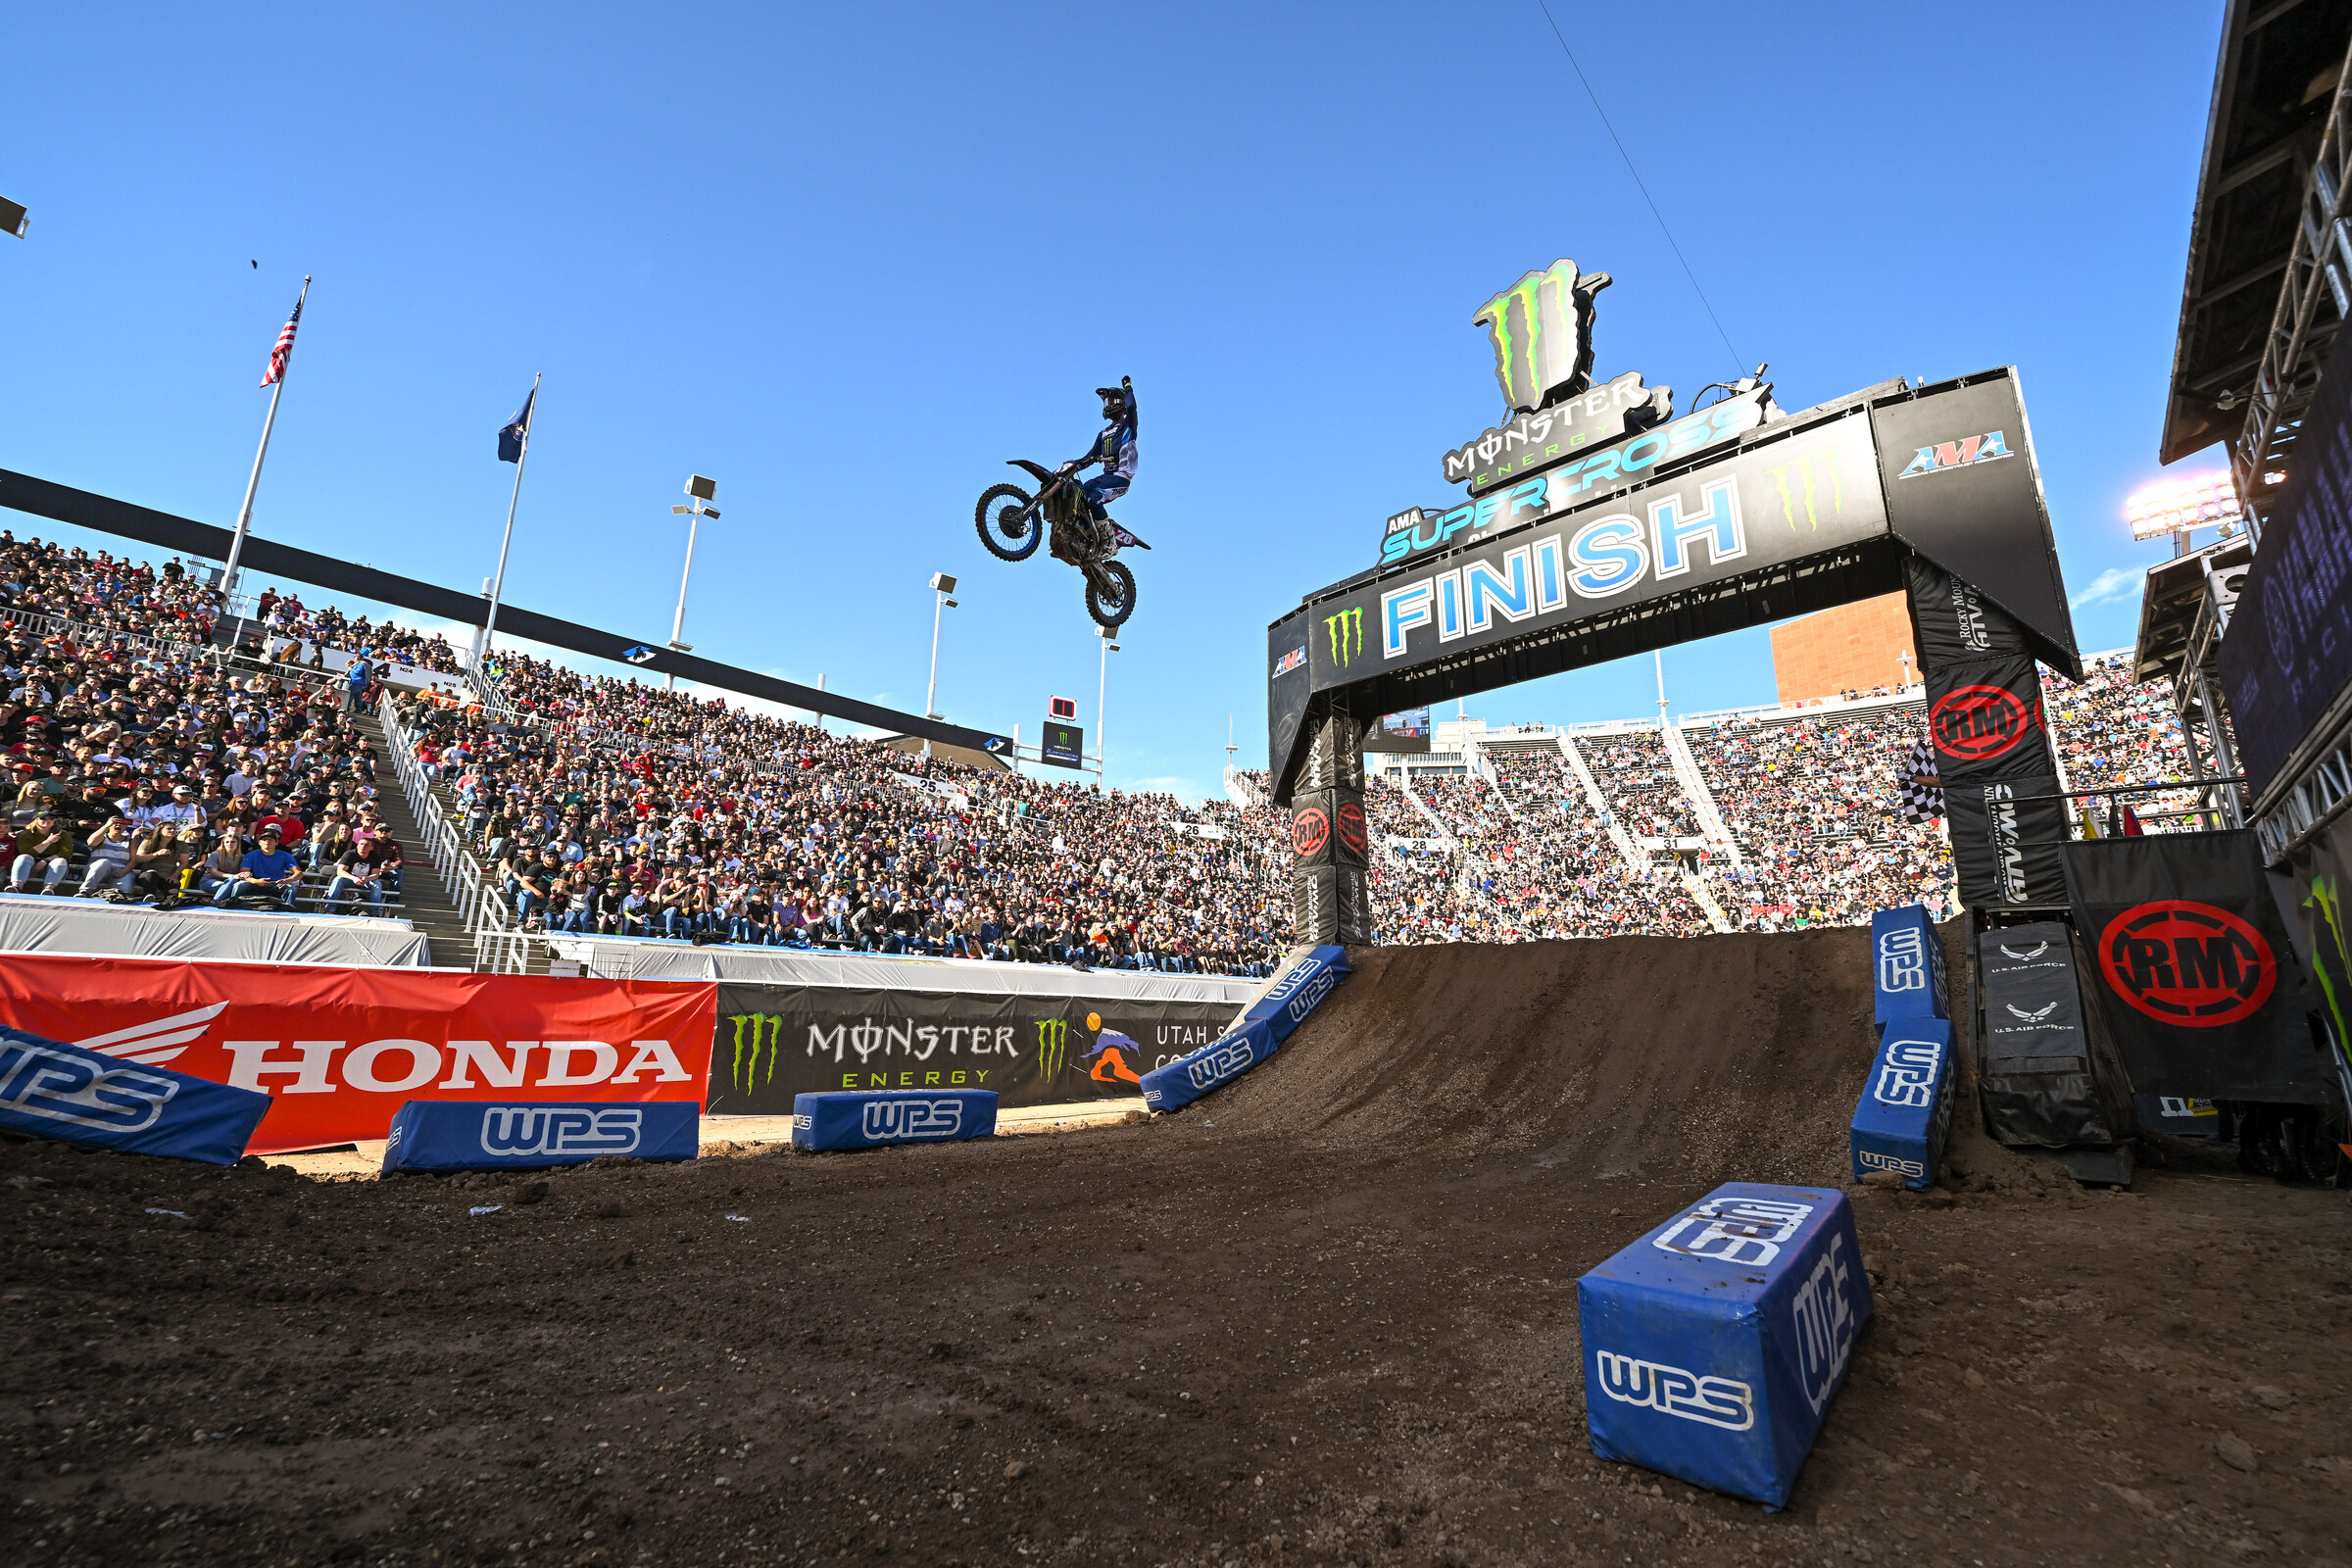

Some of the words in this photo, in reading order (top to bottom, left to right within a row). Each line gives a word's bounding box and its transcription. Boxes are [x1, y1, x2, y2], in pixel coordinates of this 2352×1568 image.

[1476, 422, 1610, 485] ENERGY
[1897, 429, 2014, 477] AMA
[1381, 397, 1757, 565] SUPERCROSS
[1389, 511, 1420, 534] AMA
[1380, 472, 1747, 661] FINISH
[1956, 608, 1972, 639] ROCKY
[1272, 644, 1307, 676] AMA
[919, 779, 937, 793] 25
[1185, 824, 1200, 836] 26
[1412, 840, 1427, 850] 28
[1663, 838, 1678, 849] 31
[1265, 957, 1322, 1001] WPS
[1881, 926, 1925, 993] WPS
[2128, 936, 2246, 989] RM
[1288, 965, 1335, 1023] WPS
[1155, 1025, 1207, 1046] UTAH
[0, 1035, 180, 1134] PS
[221, 1038, 693, 1095] HONDA
[842, 1069, 991, 1088] ENERGY
[1187, 1036, 1254, 1090] WPS
[1873, 1039, 1941, 1108] WPS
[479, 1107, 643, 1156] WPS
[862, 1100, 963, 1141] WPS
[1860, 1150, 1924, 1178] WPS
[1651, 1197, 1815, 1266] WPS
[1596, 1349, 1755, 1432] WPS
